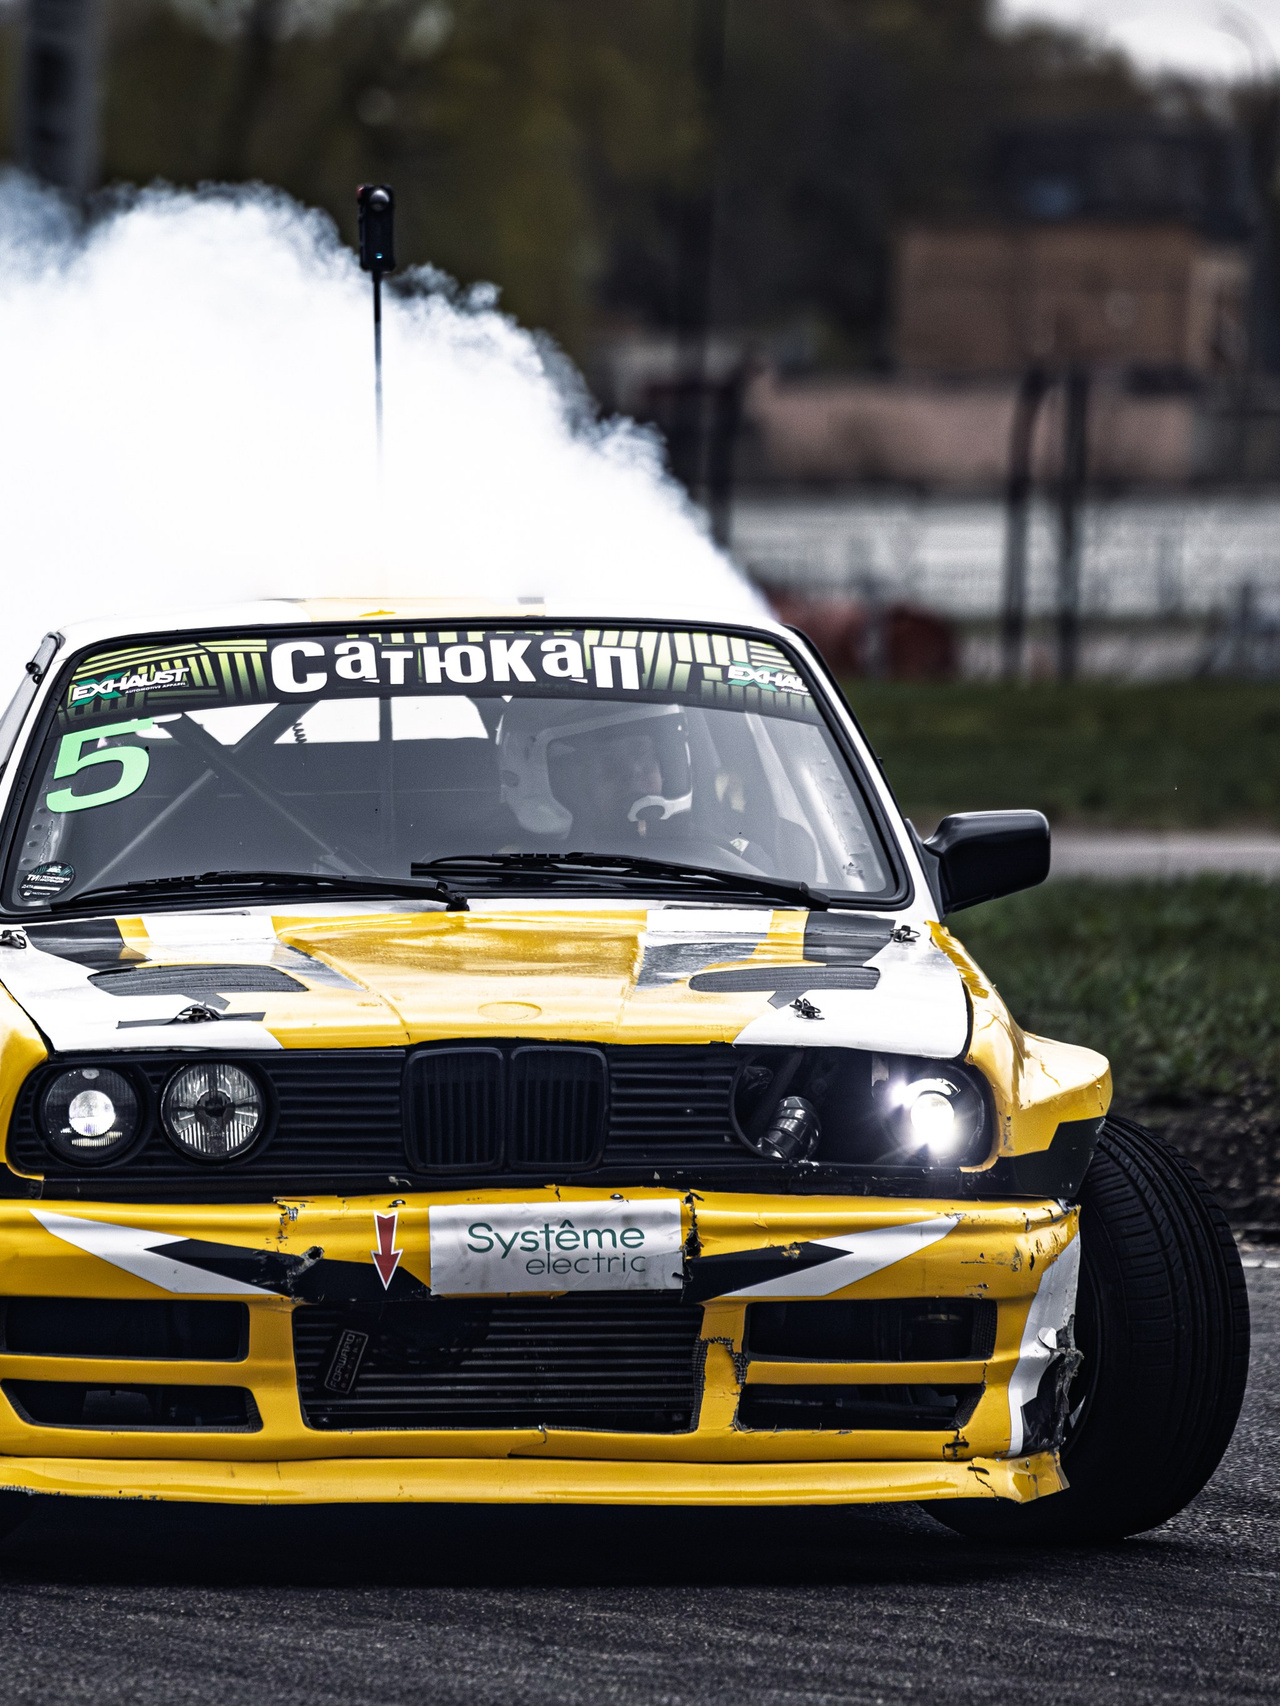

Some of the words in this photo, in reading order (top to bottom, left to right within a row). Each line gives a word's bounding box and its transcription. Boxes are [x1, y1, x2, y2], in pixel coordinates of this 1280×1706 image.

[71, 667, 190, 702] EXHAUST
[125, 685, 161, 694] AUTOMOTIVE
[46, 717, 154, 813] 5
[466, 1219, 645, 1259] Système
[525, 1252, 646, 1275] electric
[330, 1333, 356, 1388] FORWARD
